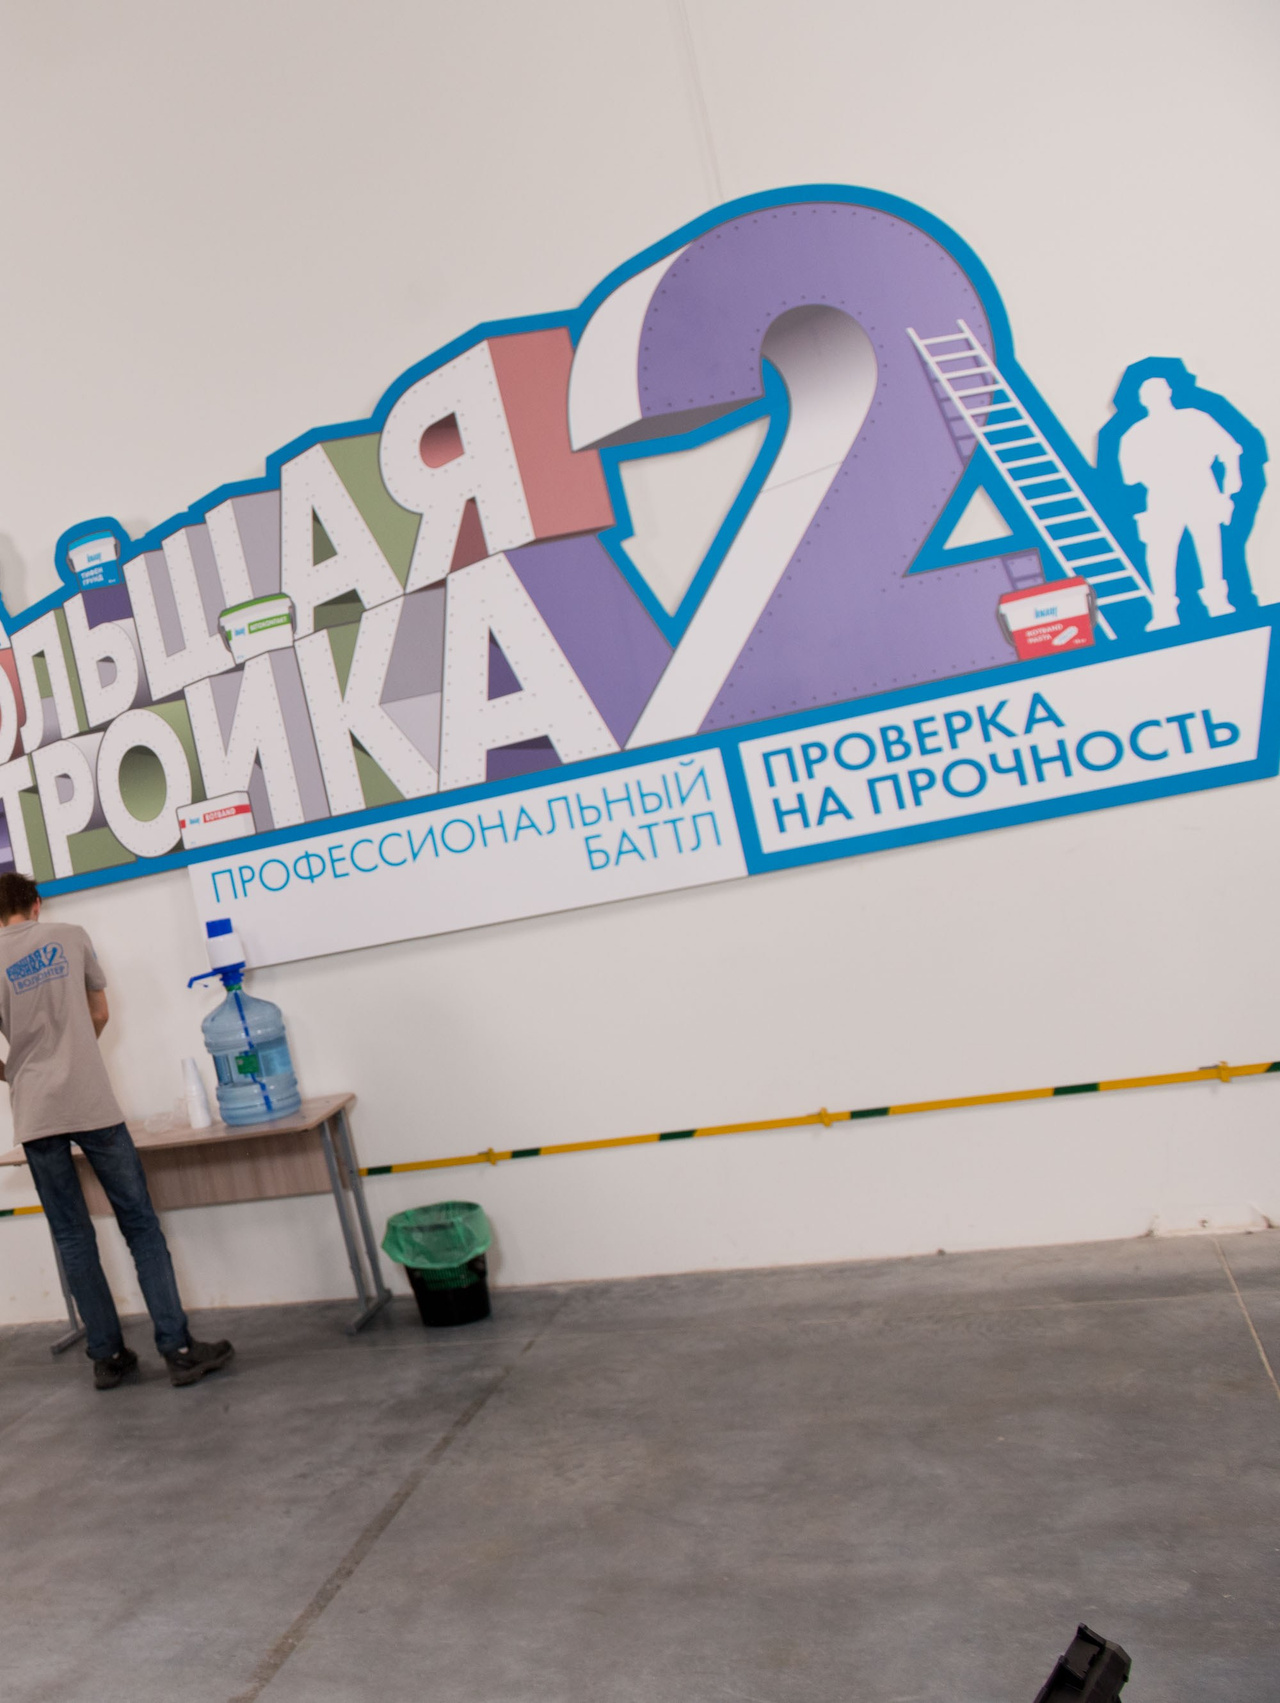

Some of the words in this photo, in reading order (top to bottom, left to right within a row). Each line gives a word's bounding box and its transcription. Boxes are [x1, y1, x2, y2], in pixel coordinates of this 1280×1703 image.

[567, 201, 1045, 751] 2
[762, 692, 1065, 787] ПРОВЕРКА
[773, 786, 853, 833] НА
[867, 709, 1240, 814] ПРОЧНОСТЬ
[211, 758, 712, 903] ПРОФЕССИОНАЛЬНЫЙ
[584, 811, 722, 870] БАТТЛ
